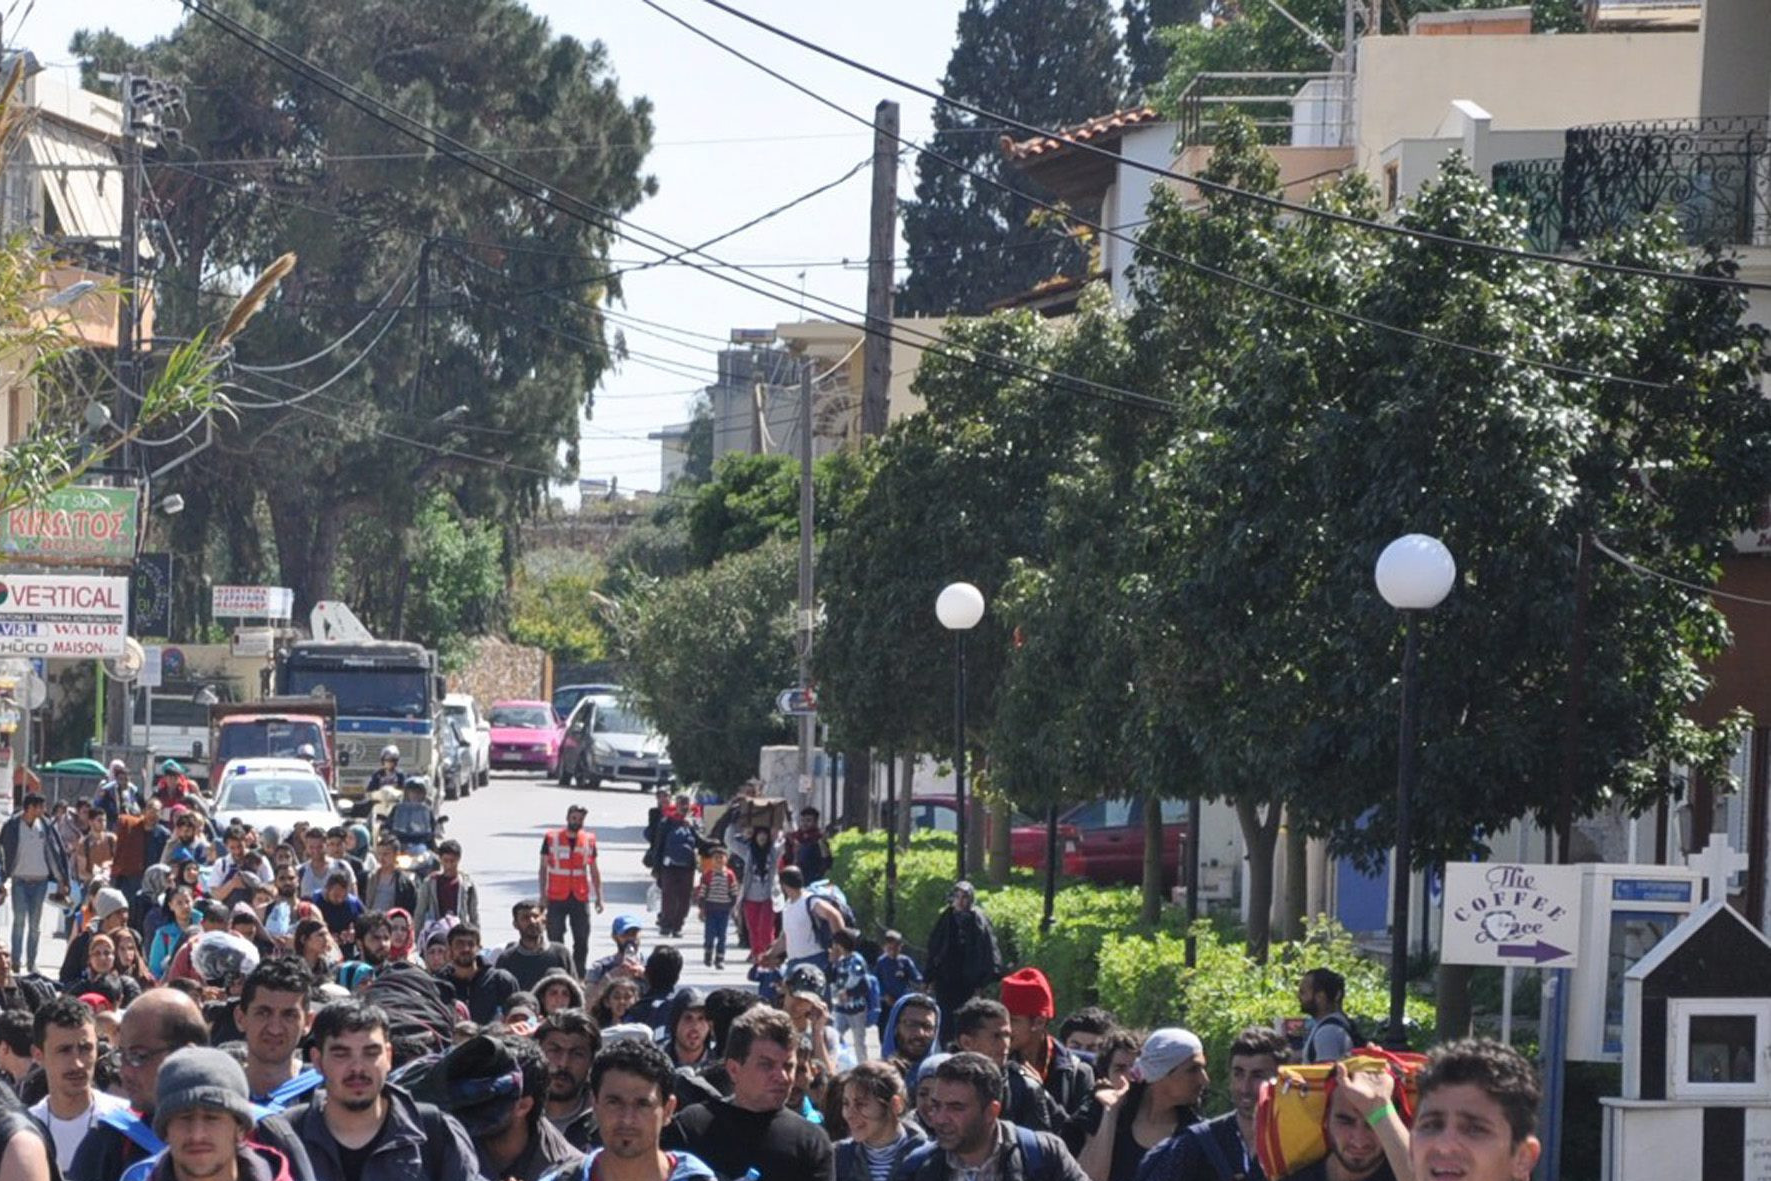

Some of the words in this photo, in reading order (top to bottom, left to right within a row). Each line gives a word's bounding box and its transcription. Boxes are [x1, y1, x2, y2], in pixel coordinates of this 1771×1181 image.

[11, 585, 120, 608] VERTICAL
[53, 641, 103, 654] MAISON
[1486, 865, 1536, 891] The
[1454, 892, 1566, 922] COFFEE
